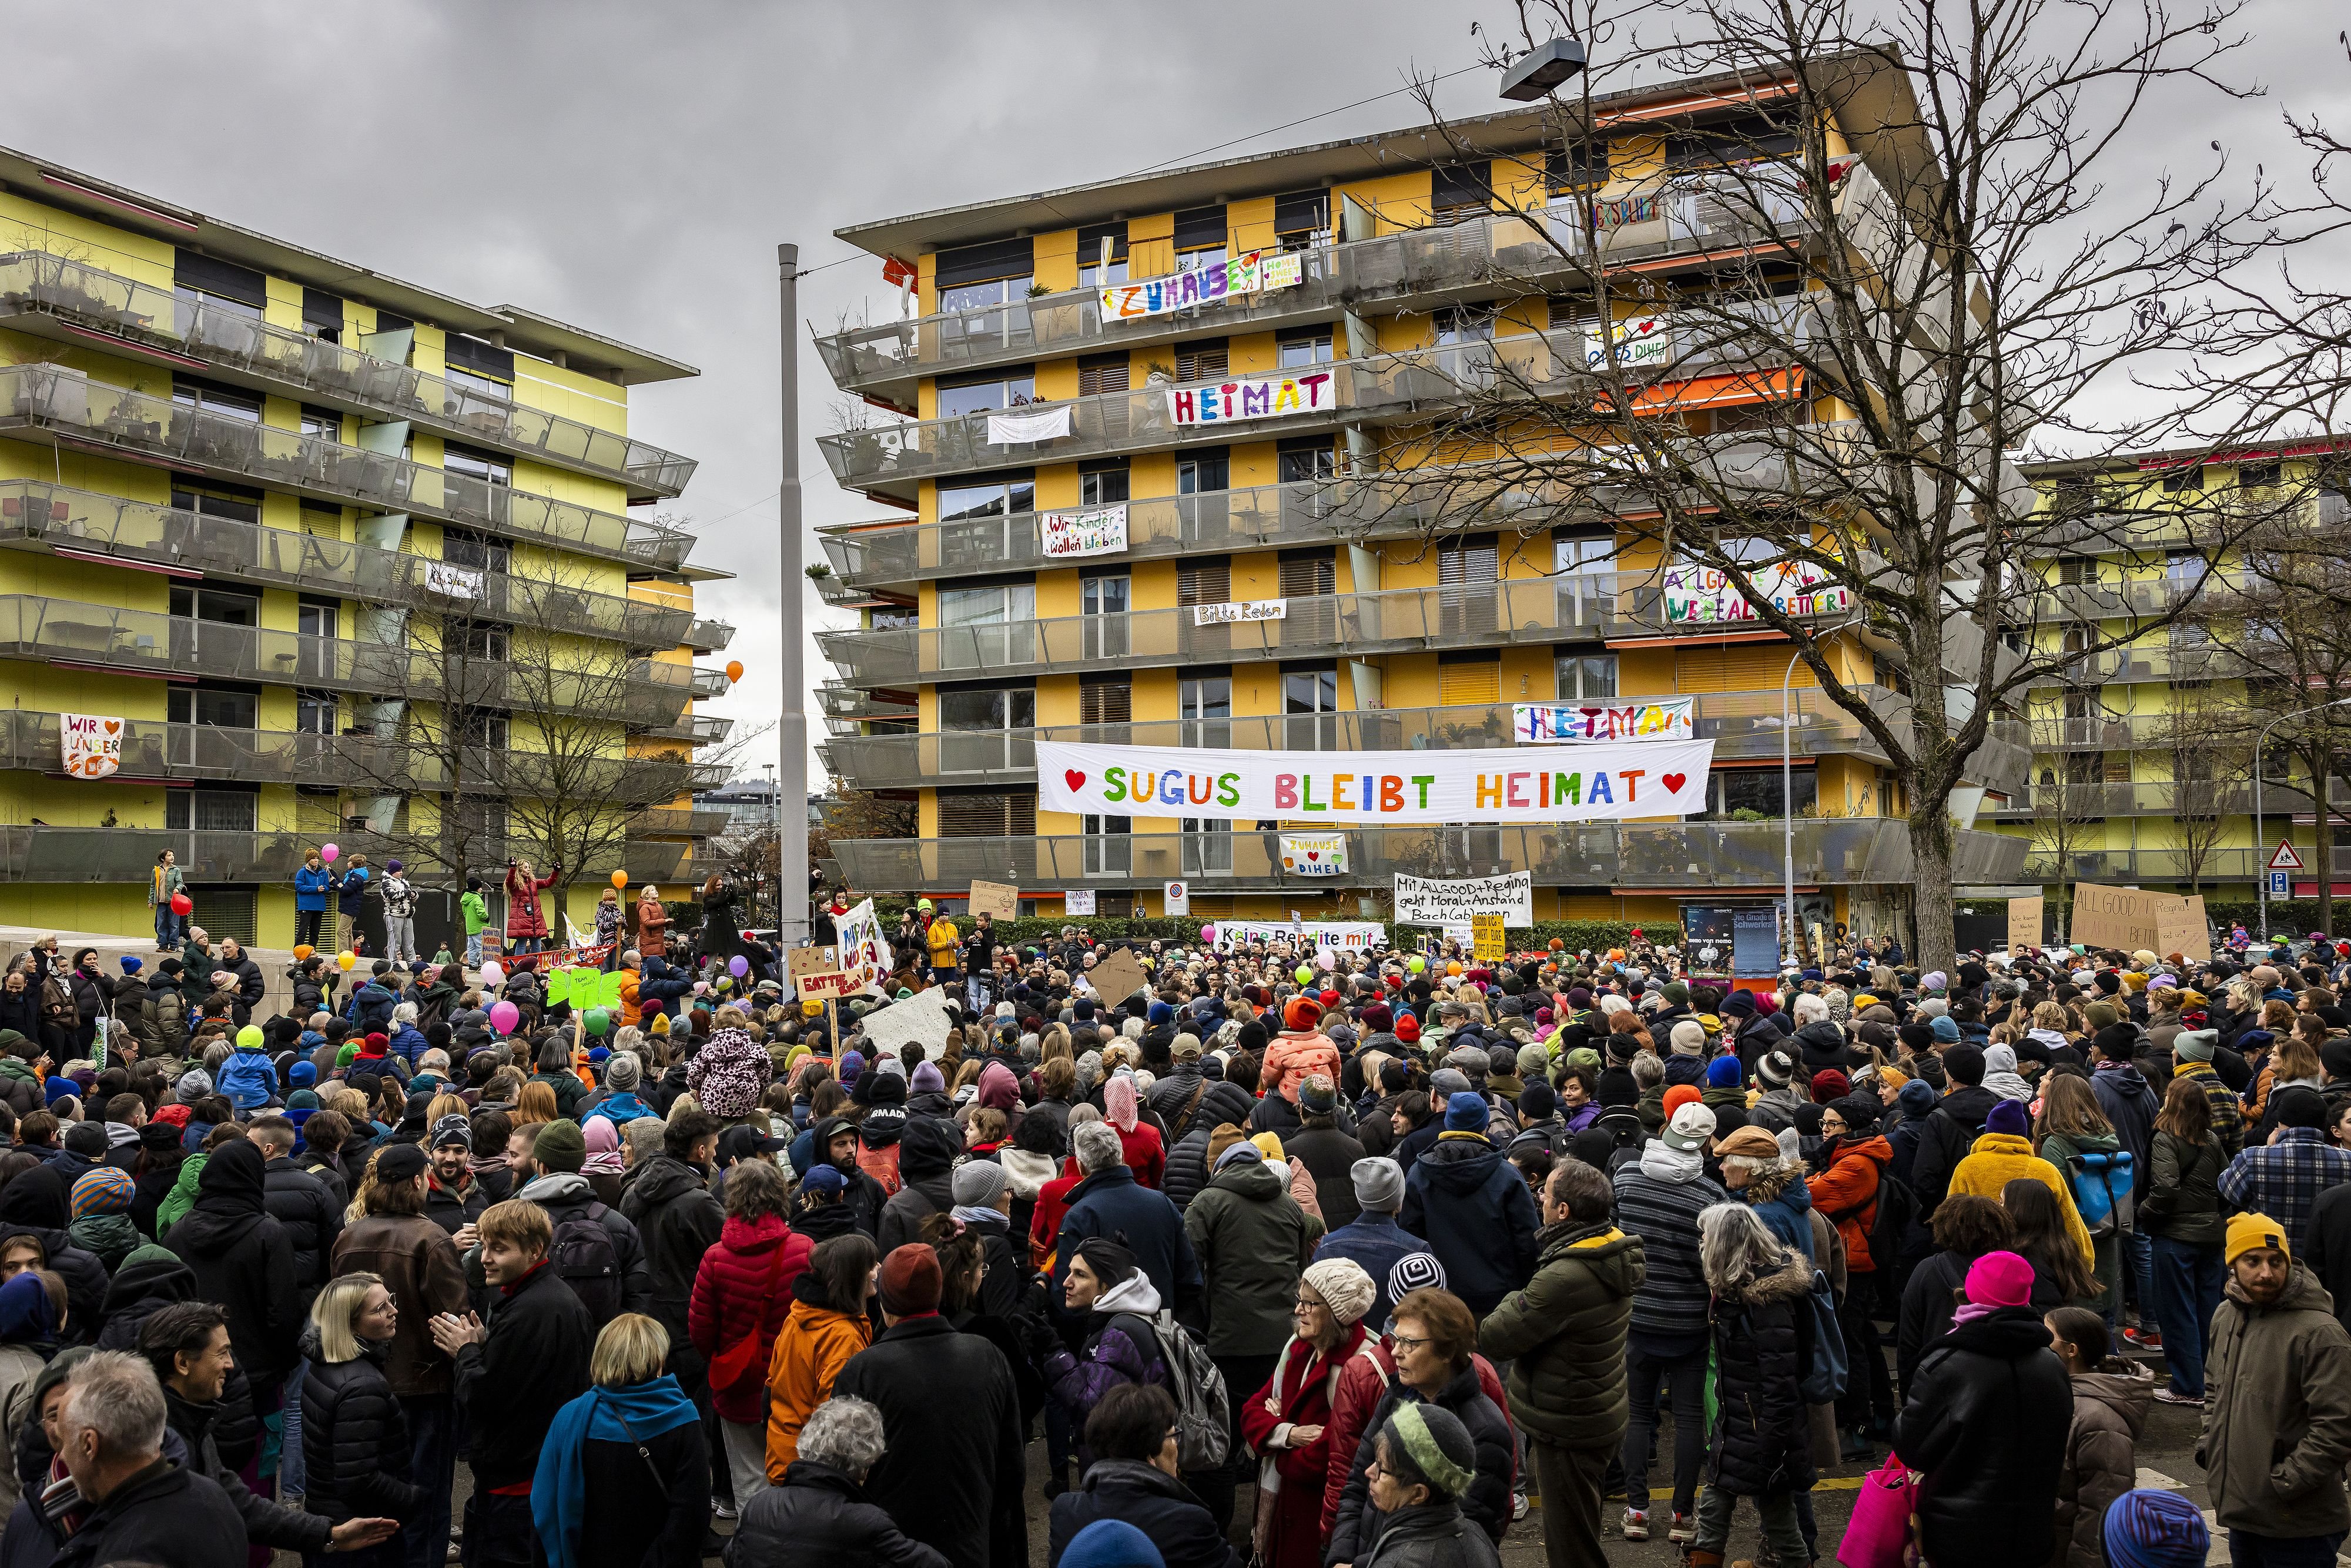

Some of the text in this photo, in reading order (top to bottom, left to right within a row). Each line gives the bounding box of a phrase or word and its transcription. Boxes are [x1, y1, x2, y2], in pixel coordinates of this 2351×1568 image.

[1267, 257, 1297, 270] HOME
[1271, 266, 1300, 280] SWEET
[1120, 259, 1241, 317] ZUHAUSE
[1268, 277, 1295, 289] HOME
[1049, 512, 1114, 532] Wir Kinder
[1084, 534, 1121, 550] bleiben
[1775, 591, 1847, 617] BETTER!
[1199, 603, 1281, 623] Bitte Reden
[68, 715, 97, 734] WIR
[1530, 705, 1688, 741] HEIMAT
[71, 736, 119, 753] UNSER
[1103, 767, 1646, 812] SUGUS BLEIBT HEIMAT
[1290, 840, 1339, 850] ZUHAUSE
[1298, 864, 1339, 874] DIHEI
[1397, 877, 1416, 891] Mit
[2275, 874, 2283, 884] P
[1399, 894, 1426, 907] geht
[2074, 890, 2099, 913] ALL
[1472, 916, 1487, 927] ALLGOOD
[1734, 920, 1776, 929] Schwerkraft
[1223, 927, 1373, 946] Keine Rendite mit
[1473, 929, 1502, 942] SANIERT EURE
[2129, 926, 2159, 947] BETTE
[803, 976, 828, 992] EAT
[827, 974, 848, 987] THE
